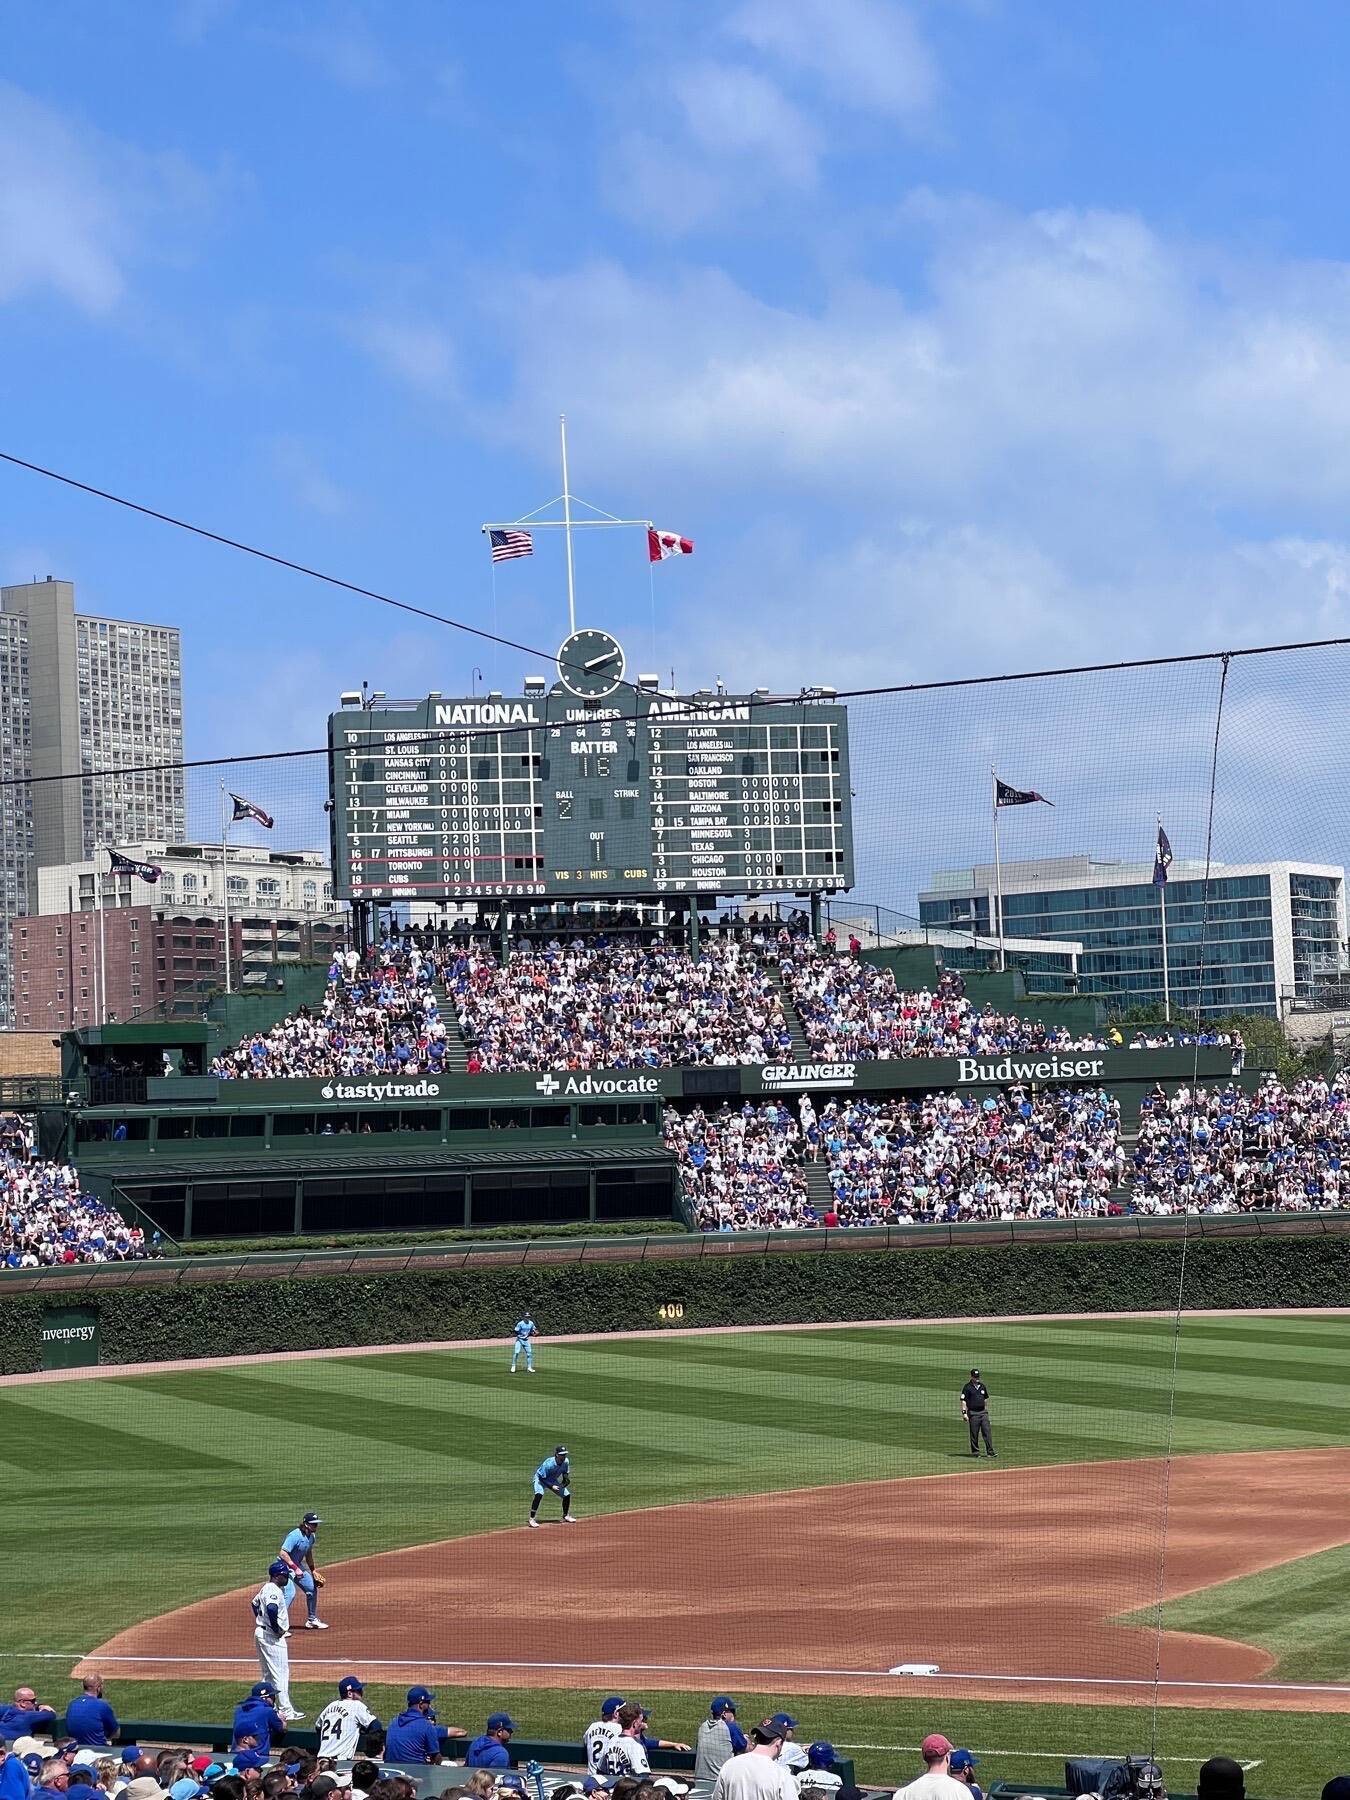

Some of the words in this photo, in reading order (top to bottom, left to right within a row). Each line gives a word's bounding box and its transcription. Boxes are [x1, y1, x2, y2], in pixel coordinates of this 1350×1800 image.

[436, 704, 540, 724] NATIONAL
[566, 709, 621, 720] UMPIRES
[647, 702, 750, 720] AMERICAN
[348, 733, 358, 743] 10
[384, 733, 395, 742] LOS
[576, 729, 586, 738] 64
[651, 729, 662, 738] 12
[688, 729, 717, 738] ATLANTA
[385, 746, 396, 754] ST.
[398, 746, 420, 754] LOUIS
[440, 745, 446, 754] 0
[450, 744, 456, 754] 0
[460, 744, 466, 753] 0
[570, 741, 618, 754] BATTER
[654, 742, 660, 750] 9
[686, 742, 698, 750] LOS
[384, 758, 414, 768] KANSAS
[415, 758, 430, 767] CITY
[440, 758, 446, 766] 0
[450, 758, 456, 766] 0
[688, 754, 700, 762] SAN
[700, 754, 734, 762] FRANCISCO
[385, 771, 426, 780] CINCINNATI
[440, 770, 446, 780] 0
[451, 770, 456, 779] 0
[652, 767, 662, 776] 12
[688, 766, 722, 775] OAKLAND
[386, 784, 428, 794] CLEVELAND
[441, 784, 446, 792] 0
[451, 783, 457, 792] 0
[462, 783, 467, 792] 0
[472, 782, 478, 792] 0
[655, 780, 662, 788] 3
[688, 780, 717, 788] BOSTON
[742, 778, 748, 787] 0
[752, 778, 758, 787] 0
[762, 778, 768, 786] 0
[772, 778, 778, 786] 0
[783, 778, 788, 786] 0
[793, 777, 798, 786] 0
[614, 790, 640, 798] STRIKE
[654, 792, 664, 802] 14
[689, 792, 729, 800] BALTIMORE
[350, 798, 360, 807] 13
[386, 797, 428, 806] MILWAUKEE
[559, 800, 571, 820] 2
[656, 804, 663, 814] 4
[690, 804, 722, 813] ARIZONA
[372, 811, 378, 820] 7
[387, 810, 410, 819] MIAMI
[654, 818, 664, 827] 10
[673, 818, 684, 827] 15
[690, 818, 713, 826] TAMPA
[714, 817, 728, 826] BAY
[372, 824, 378, 832] 7
[387, 824, 402, 832] NEW
[354, 836, 360, 846] 5
[388, 836, 418, 844] SEATTLE
[442, 835, 448, 844] 2
[452, 835, 459, 844] 2
[463, 834, 468, 844] 0
[474, 834, 480, 844] 3
[590, 832, 605, 840] OUT
[656, 830, 664, 840] 7
[690, 830, 732, 838] MINNESOTA
[744, 829, 750, 838] 3
[691, 842, 714, 850] TEXAS
[744, 842, 750, 850] 0
[352, 850, 362, 859] 16
[372, 849, 380, 858] 17
[388, 848, 434, 858] PITTSBURGH
[442, 848, 448, 856] 0
[454, 848, 459, 856] 0
[464, 847, 470, 856] 0
[474, 847, 480, 856] 0
[658, 856, 665, 865] 3
[692, 855, 724, 864] CHICAGO
[746, 854, 752, 863] 0
[756, 854, 762, 863] 0
[766, 854, 772, 862] 0
[776, 854, 782, 862] 0
[351, 862, 362, 872] 44
[388, 861, 422, 870] TORONTO
[352, 876, 362, 884] 18
[389, 875, 409, 884] CUBS
[444, 874, 450, 882] 0
[454, 873, 460, 882] 0
[555, 870, 570, 880] VIS
[576, 870, 583, 880] 3
[590, 870, 608, 880] HITS
[624, 870, 648, 878] CUBS
[656, 868, 666, 878] 13
[692, 868, 726, 877] HOUSTON
[656, 882, 667, 890] SP
[676, 882, 686, 890] RP
[696, 880, 721, 890] INNING
[748, 880, 751, 889] 1
[756, 880, 762, 889] 2
[766, 880, 772, 888] 3
[776, 880, 783, 888] 4
[786, 880, 793, 888] 5
[796, 879, 802, 888] 6
[807, 879, 814, 888] 7
[817, 878, 823, 888] 8
[827, 878, 833, 888] 9
[836, 878, 846, 888] 10
[352, 888, 363, 897] SP
[372, 888, 382, 896] RP
[392, 888, 418, 896] INNING
[444, 887, 448, 896] 1
[454, 886, 460, 896] 2
[466, 886, 472, 896] 3
[475, 886, 482, 895] 4
[486, 886, 492, 895] 5
[496, 886, 502, 894] 6
[506, 886, 513, 894] 7
[517, 886, 523, 894] 8
[528, 885, 534, 894] 9
[536, 885, 546, 894] 10
[761, 1063, 856, 1080] GRAINGER
[958, 1056, 1102, 1082] Budweiser
[564, 1074, 659, 1096] Advocate
[336, 1080, 440, 1102] tastytrade
[658, 1303, 684, 1318] 400
[40, 1326, 96, 1340] nvenergy
[322, 1718, 342, 1740] 24
[592, 1740, 604, 1763] 2
